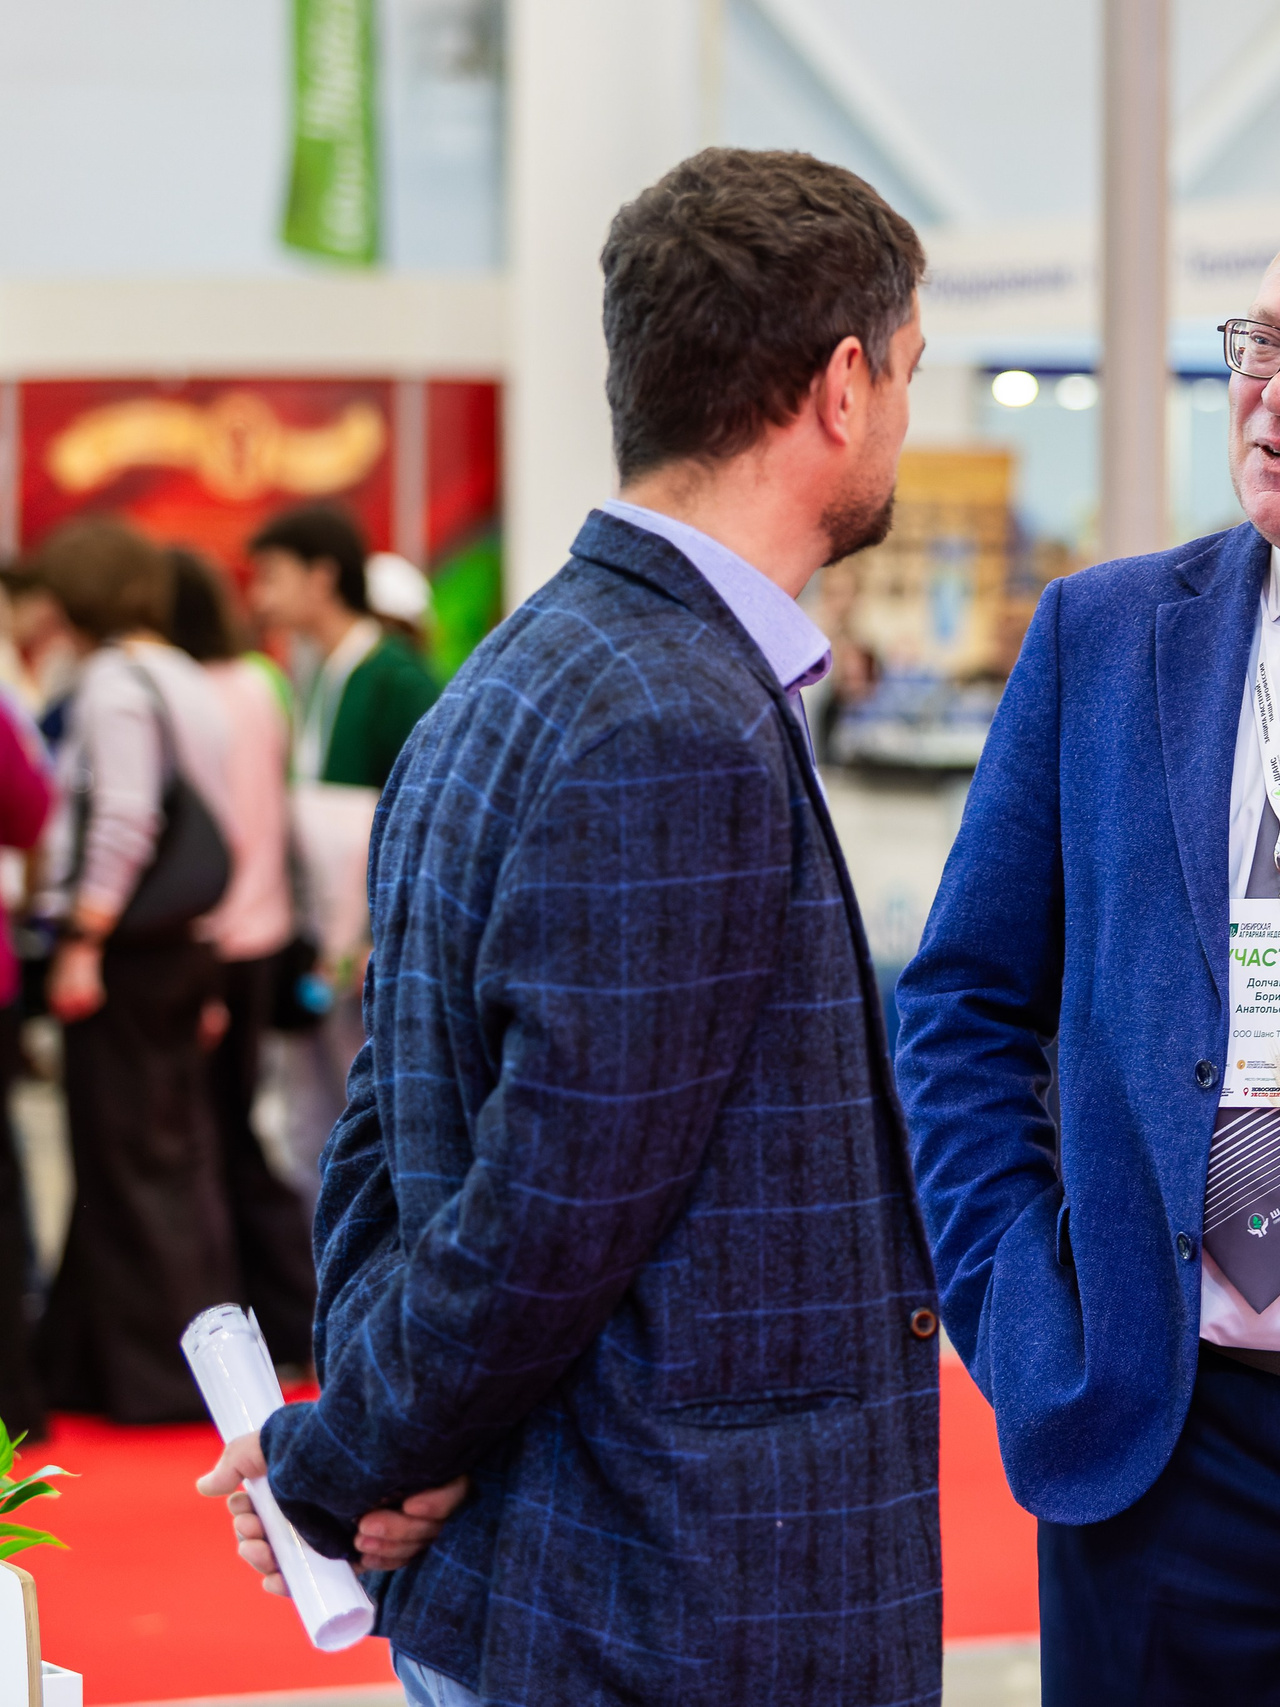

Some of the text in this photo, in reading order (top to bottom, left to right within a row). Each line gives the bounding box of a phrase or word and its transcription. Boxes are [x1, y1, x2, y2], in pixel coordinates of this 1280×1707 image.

[1254, 683, 1266, 718] РАСТЕНИЙ
[1259, 662, 1275, 723] НАША ПРОФЕССИЯ
[1261, 717, 1271, 745] ЗАЩИТА
[1232, 1029, 1252, 1038] ООО
[1253, 1029, 1275, 1038] Шанс
